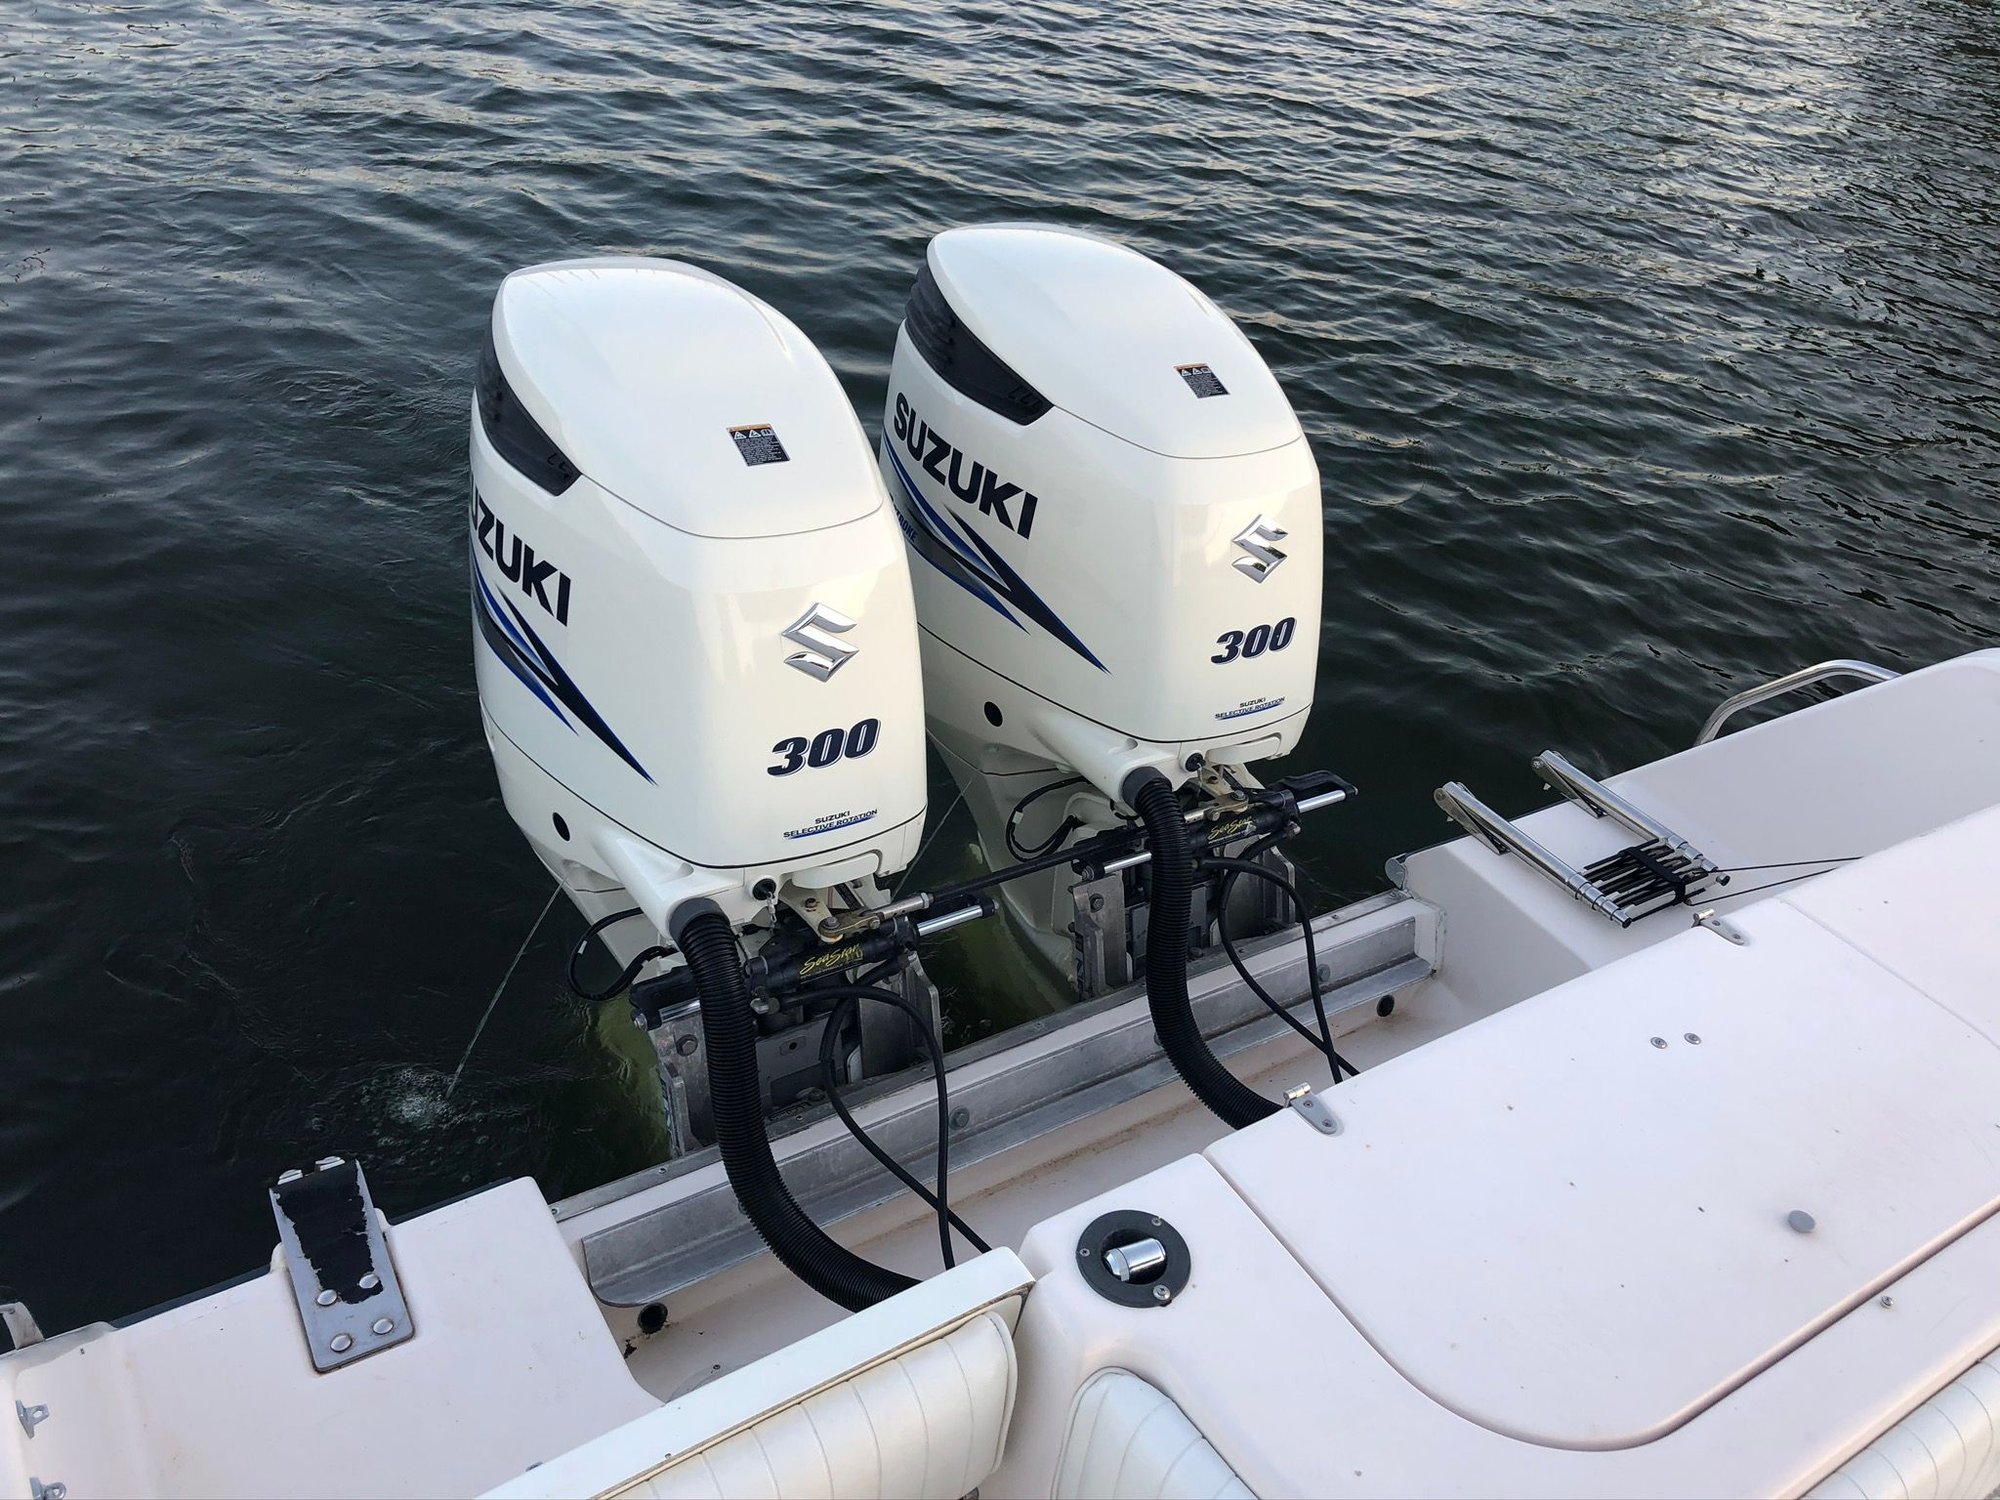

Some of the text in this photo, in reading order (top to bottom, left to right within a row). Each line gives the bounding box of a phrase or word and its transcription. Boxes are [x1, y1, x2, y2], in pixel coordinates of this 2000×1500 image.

[894, 392, 1038, 540] SUZUKI
[471, 472, 571, 627] UZUKI
[1211, 617, 1297, 664] 300
[1215, 705, 1254, 719] SELECTIVE
[1240, 697, 1266, 708] SUZUKI
[767, 718, 881, 776] 300
[783, 808, 878, 838] SELECTIVE ROTATION
[815, 810, 850, 825] SUZUKI
